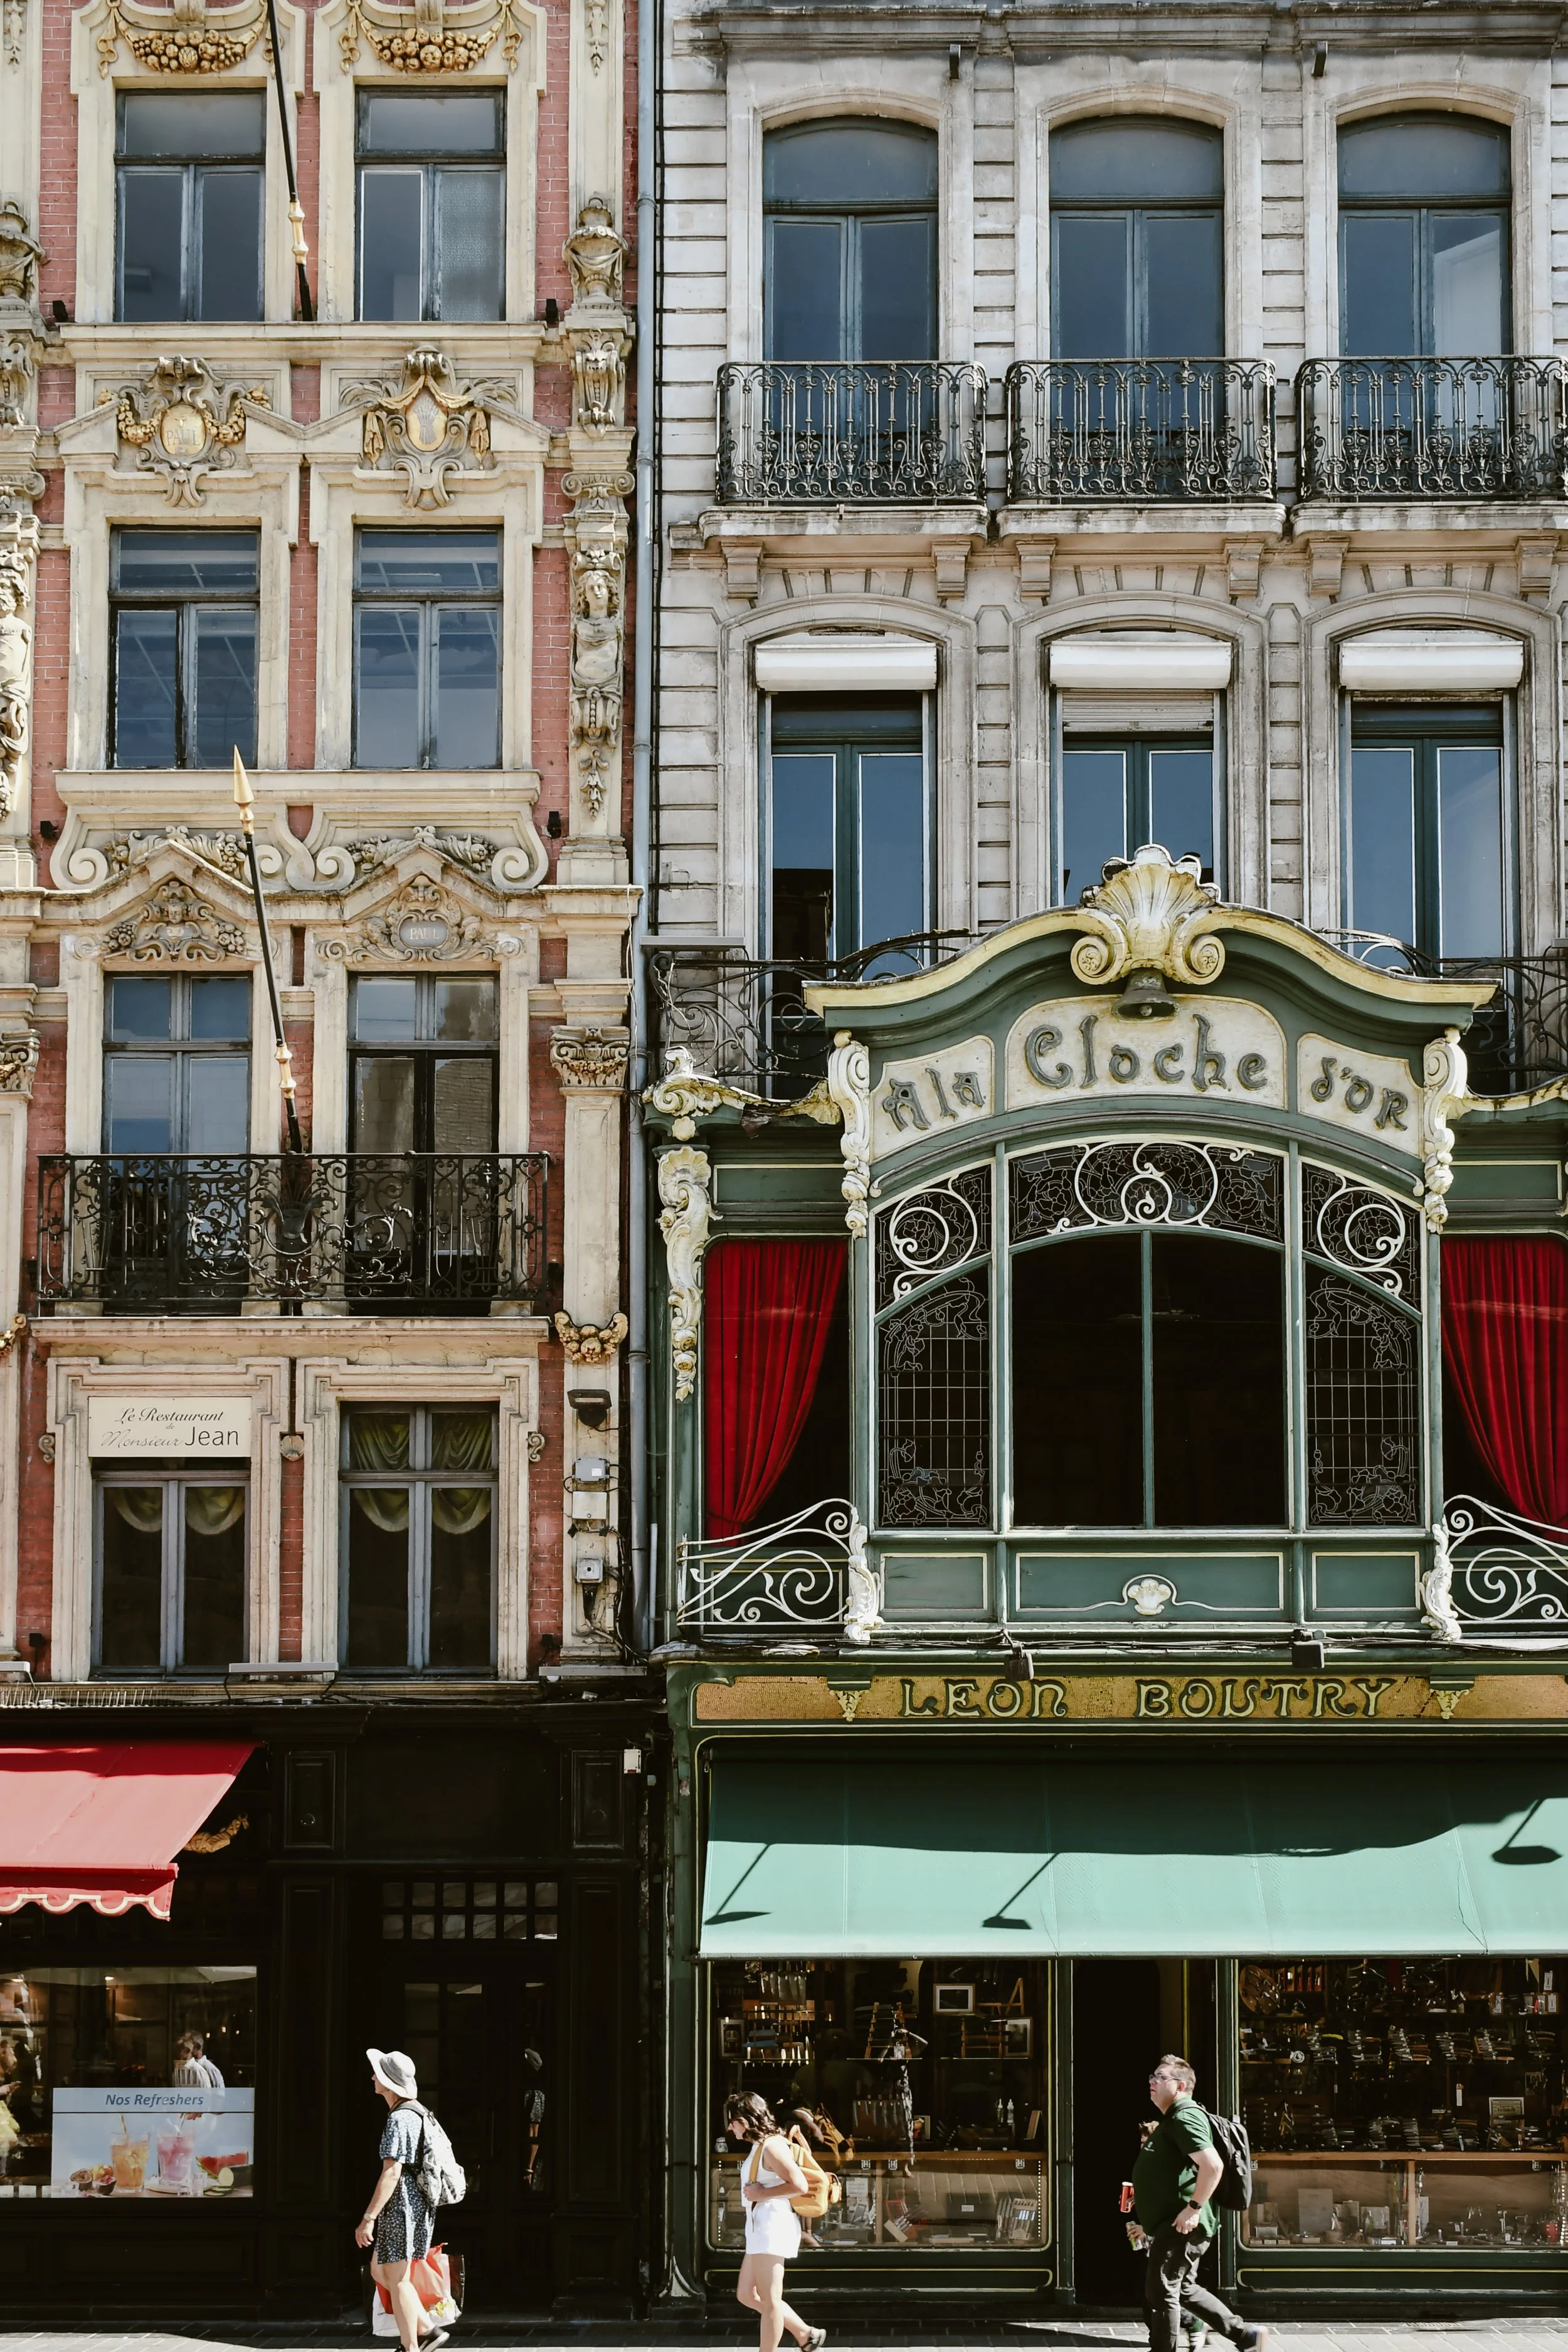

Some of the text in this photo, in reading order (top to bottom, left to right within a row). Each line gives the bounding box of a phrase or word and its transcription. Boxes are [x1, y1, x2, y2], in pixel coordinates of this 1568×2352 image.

[166, 429, 200, 446] PAUL
[409, 928, 439, 940] PAUL
[1024, 1014, 1269, 1093] Cloche
[114, 1407, 224, 1425] Le Restaurant
[100, 1426, 239, 1448] Monsieur Jean
[899, 1677, 1396, 1717] LEON BOUTRY
[105, 2094, 204, 2107] Nos Refreshers
